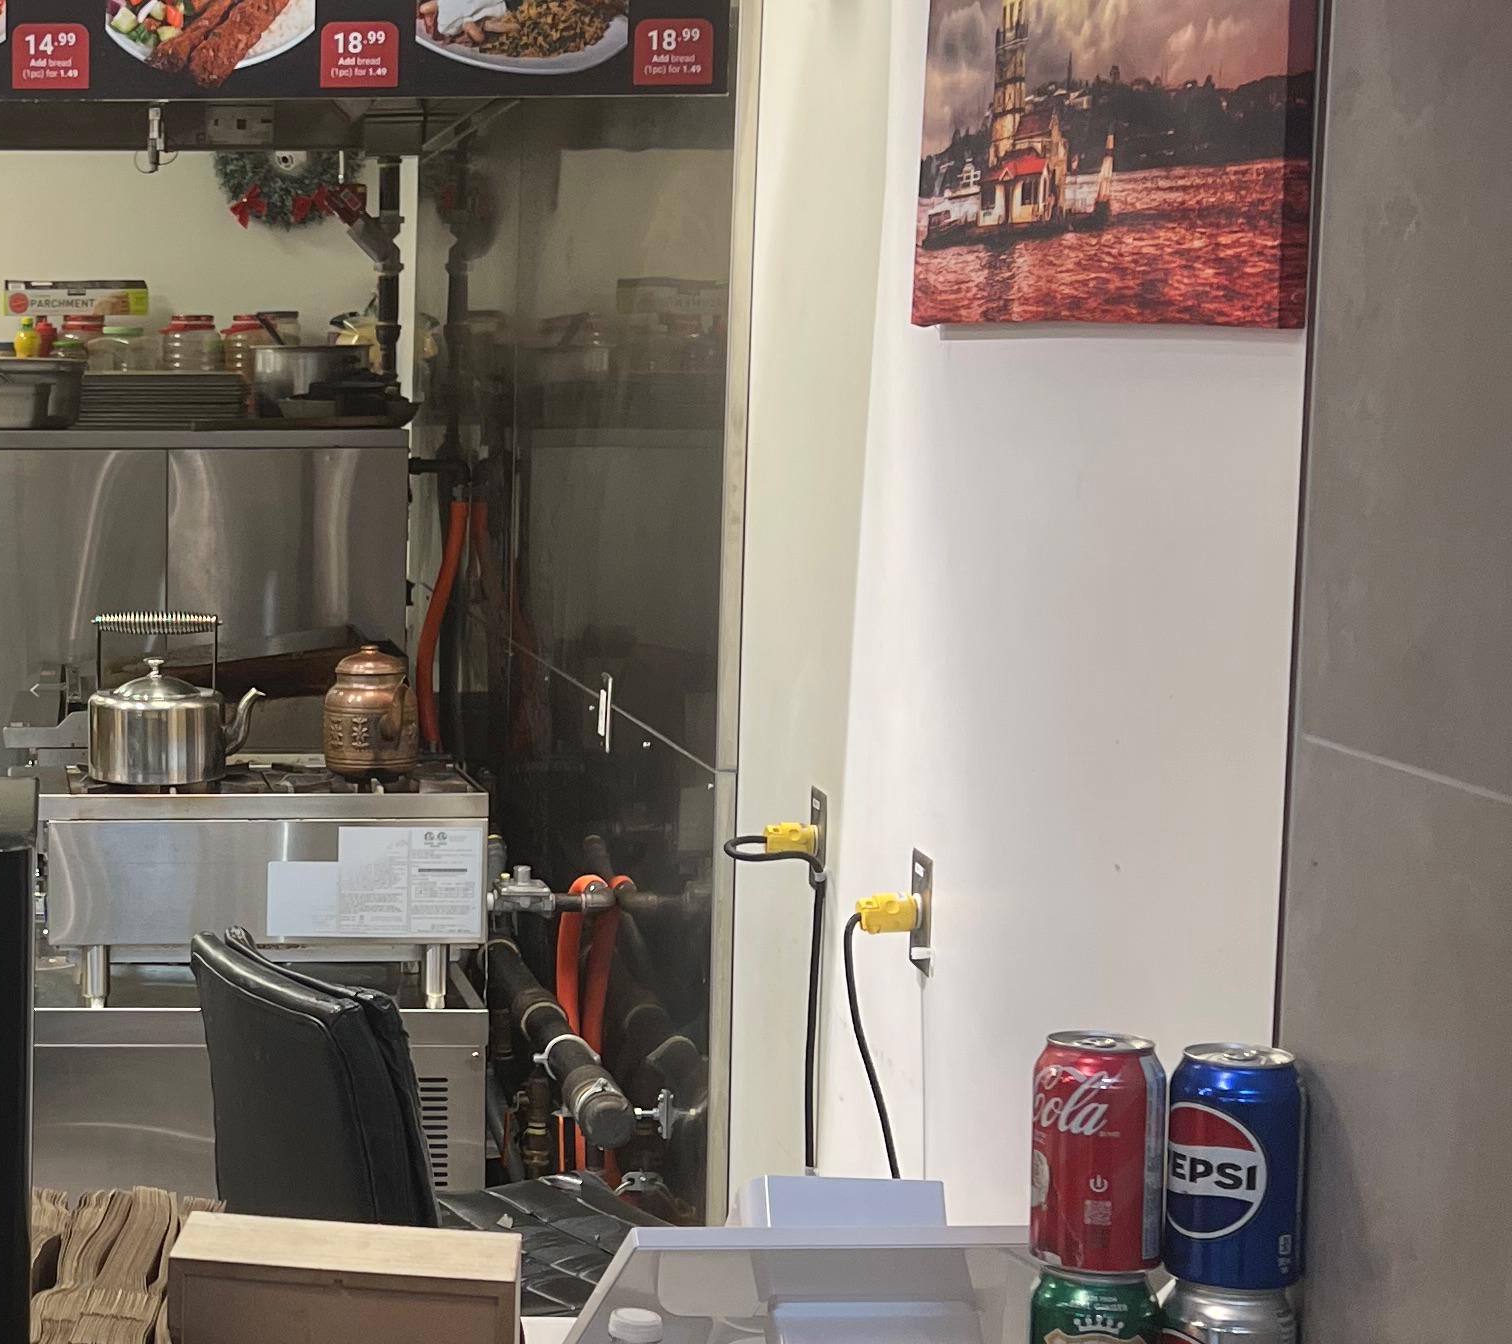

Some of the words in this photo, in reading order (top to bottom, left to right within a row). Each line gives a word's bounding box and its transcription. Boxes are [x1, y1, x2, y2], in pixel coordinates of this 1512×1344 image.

[25, 33, 76, 55] 14.99
[334, 31, 385, 53] 18.99
[648, 28, 700, 50] 18.99
[30, 298, 95, 308] PARCHMENT
[1171, 1151, 1257, 1190] EPSI
